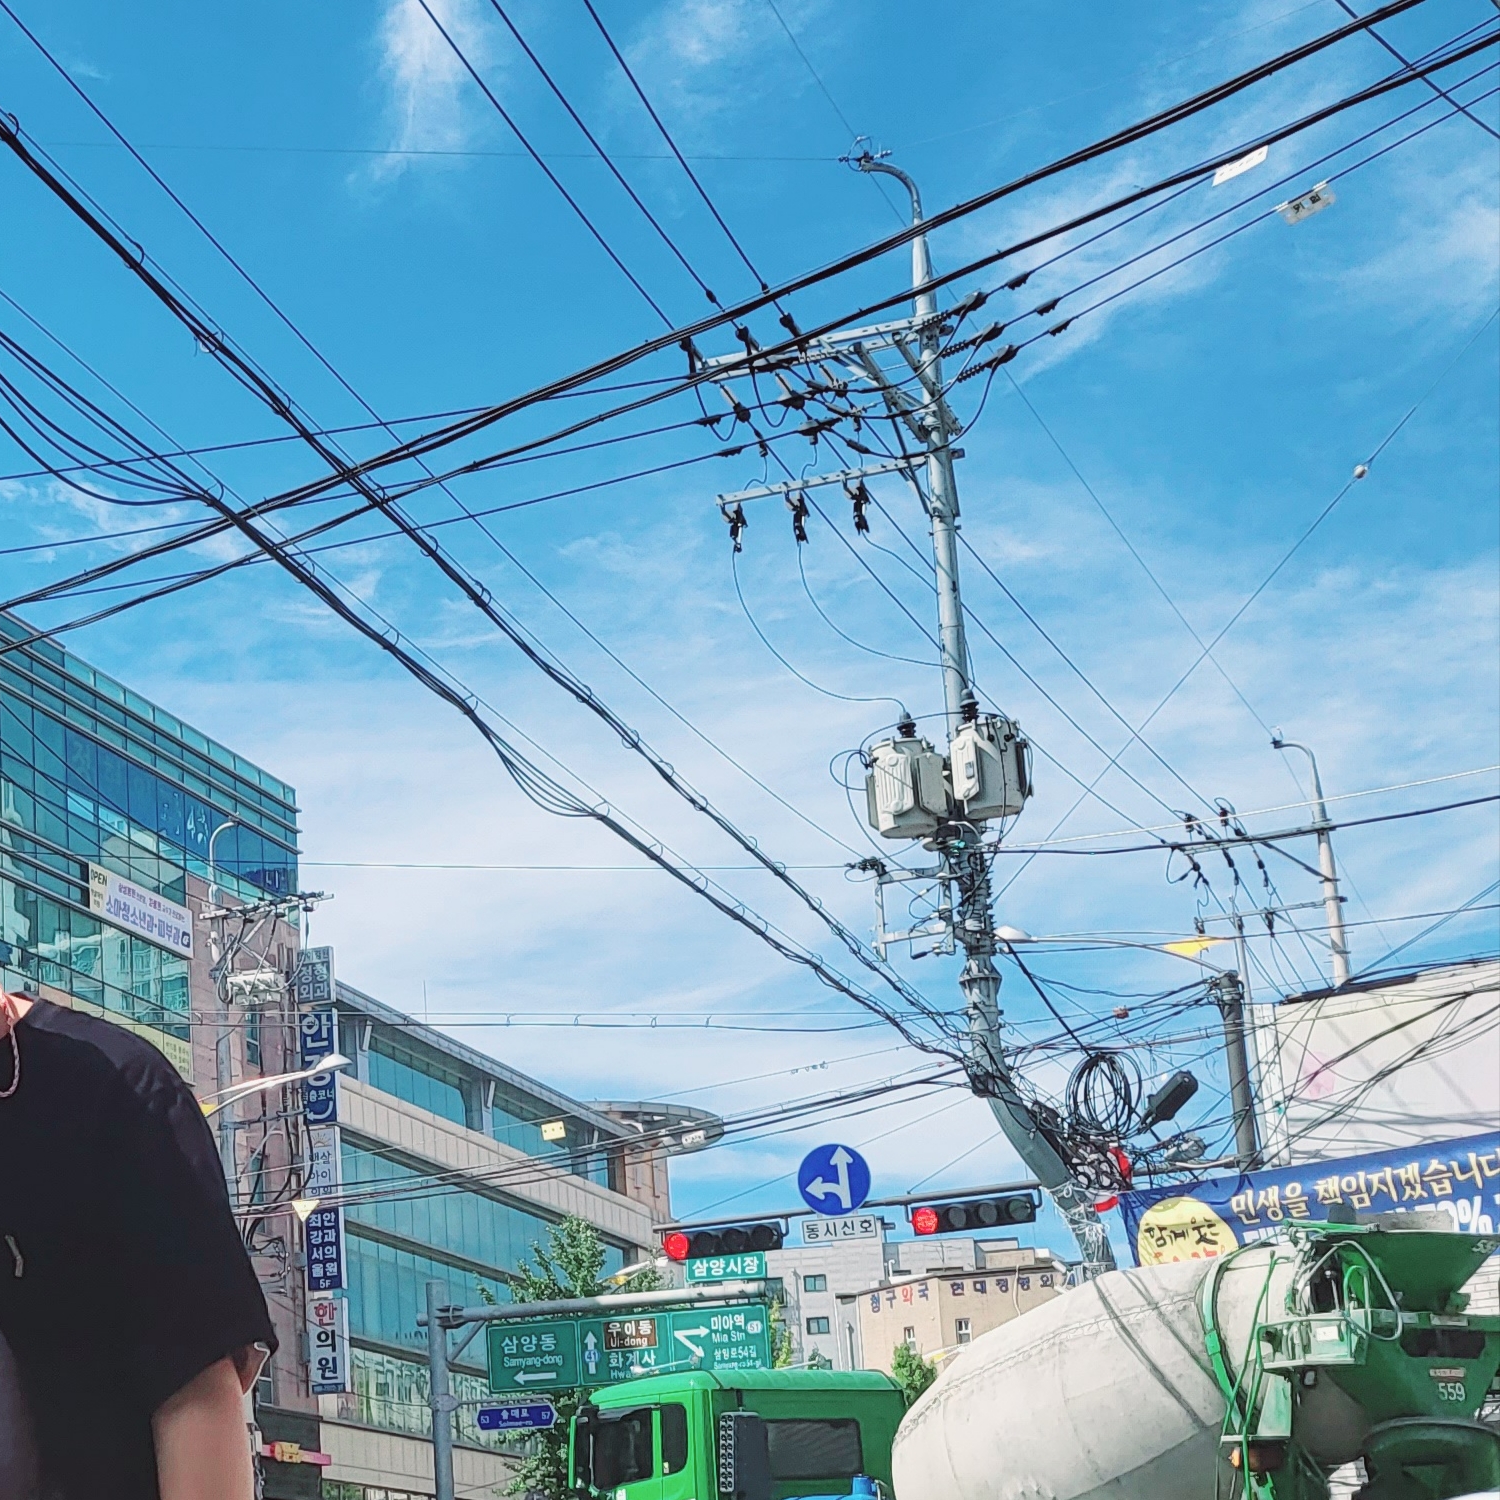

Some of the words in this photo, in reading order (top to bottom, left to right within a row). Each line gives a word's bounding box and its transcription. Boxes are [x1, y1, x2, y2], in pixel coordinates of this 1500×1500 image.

[1230, 1181, 1311, 1224] 민생을
[805, 1219, 875, 1241] 동시신호
[691, 1257, 760, 1277] 삼양시장
[607, 1320, 653, 1338] 우이동
[710, 1313, 746, 1333] 미아역
[313, 1302, 340, 1381] 한의원
[500, 1333, 557, 1355] 삼양동
[502, 1354, 564, 1369] Samyang-dong
[1438, 1381, 1467, 1402] 559
